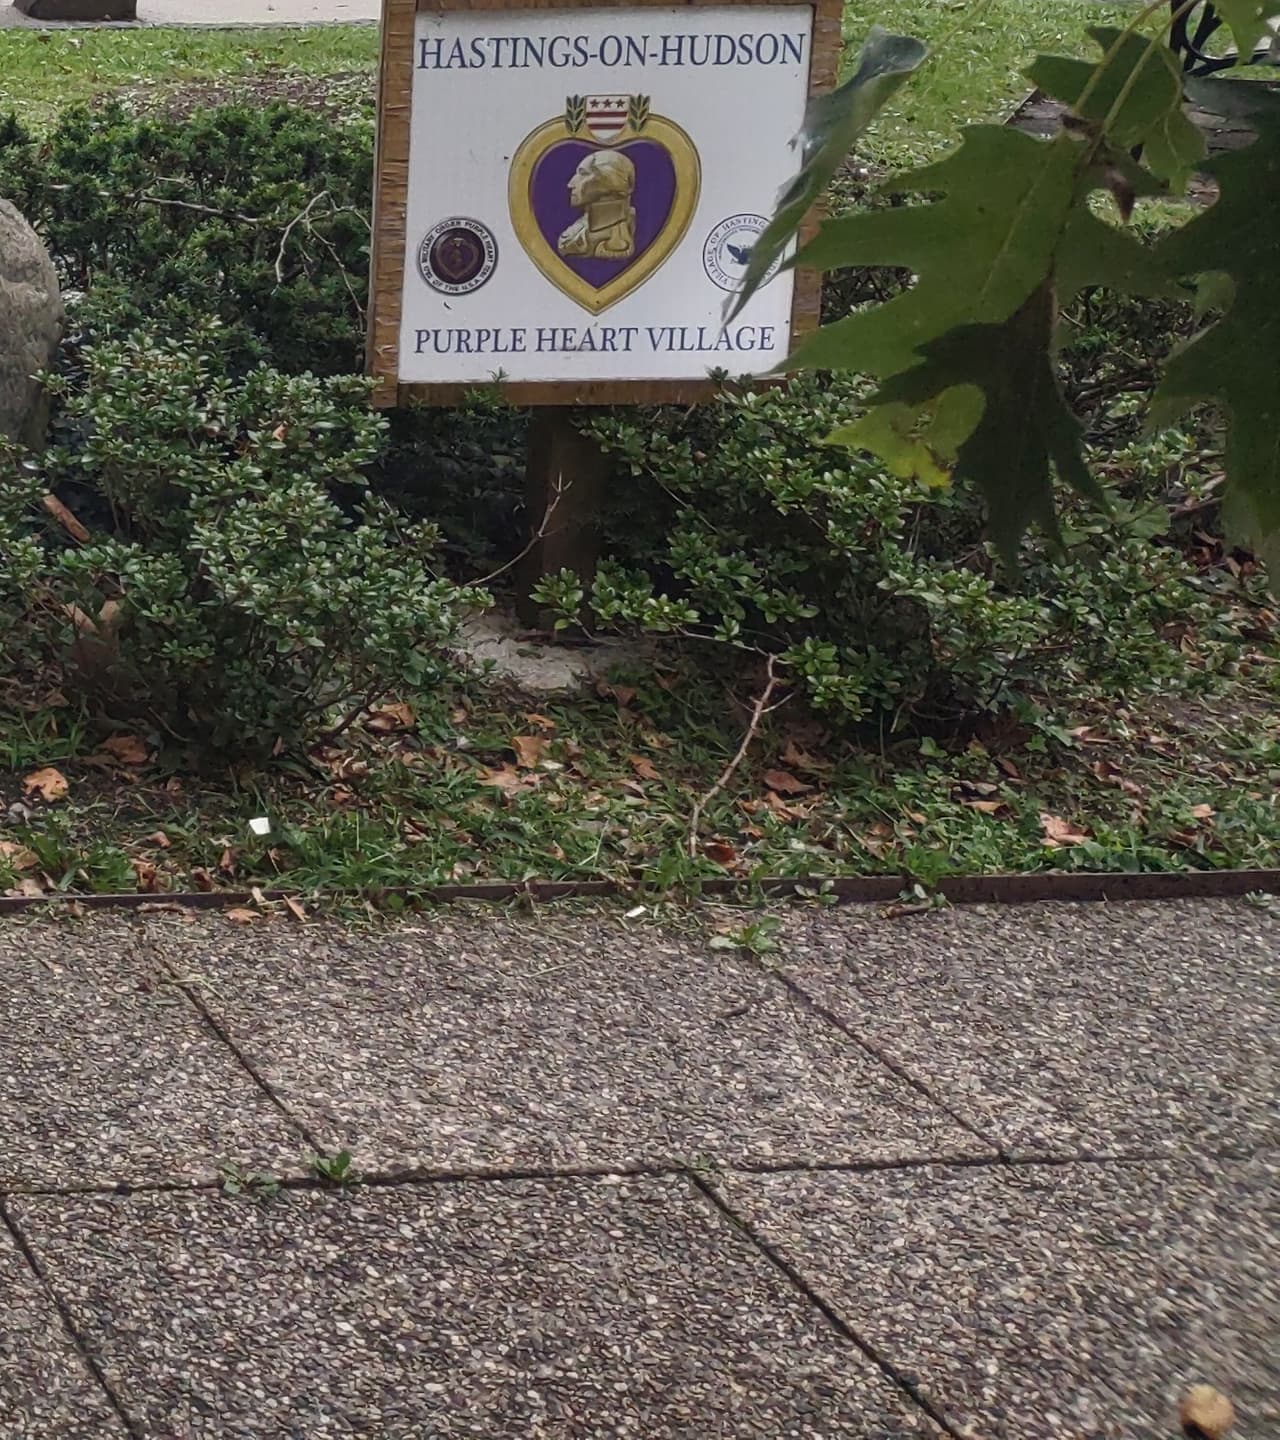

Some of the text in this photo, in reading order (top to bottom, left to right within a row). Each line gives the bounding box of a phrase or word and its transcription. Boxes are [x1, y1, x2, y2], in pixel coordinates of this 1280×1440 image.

[416, 33, 807, 70] HASTINGS-ON-HUDSON
[434, 220, 462, 235] ORDER
[464, 221, 489, 241] PURPLE
[722, 217, 766, 231] HASTING
[710, 231, 721, 245] OF
[706, 249, 729, 285] VILLAGE
[444, 284, 460, 292] THE
[415, 326, 776, 353] PURPLE HEART VILLAGE
